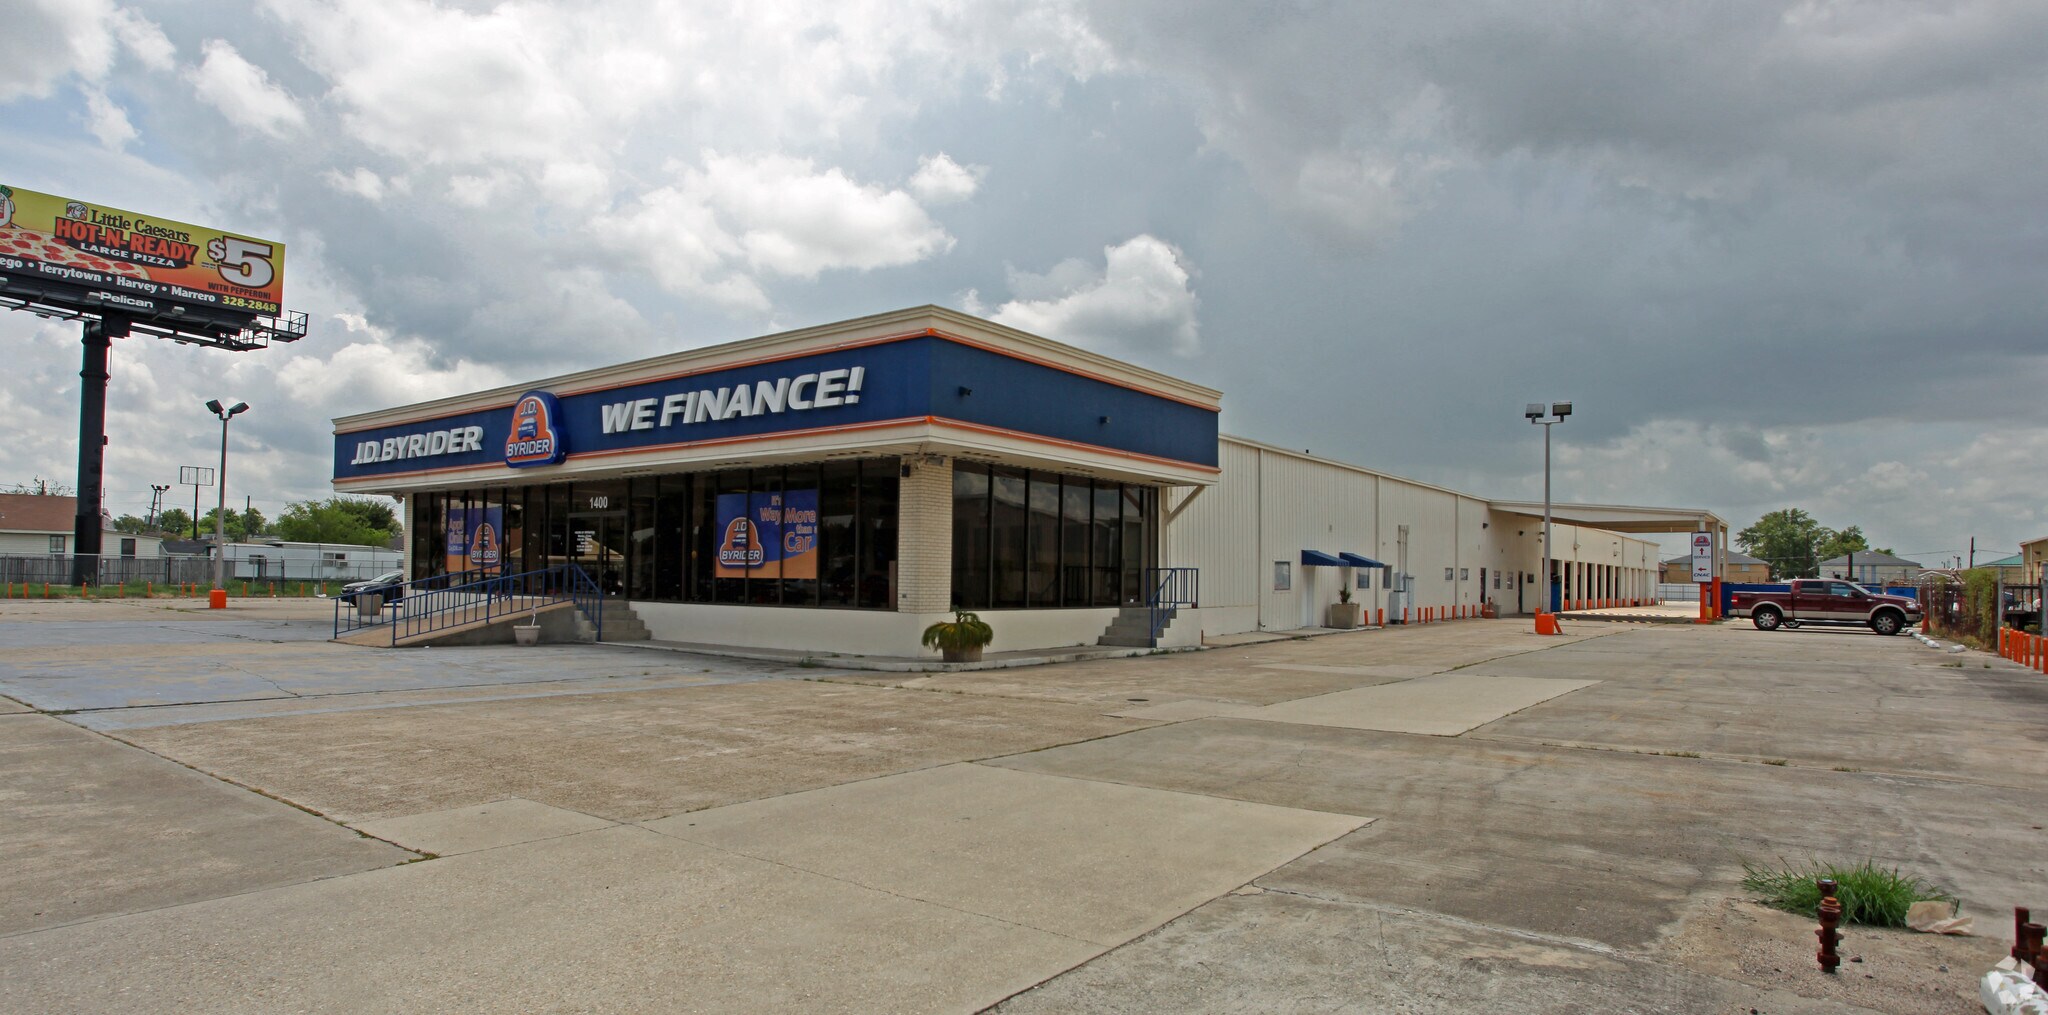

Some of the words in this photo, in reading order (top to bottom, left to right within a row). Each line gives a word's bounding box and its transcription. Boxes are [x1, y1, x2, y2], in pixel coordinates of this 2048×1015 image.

[91, 208, 131, 230] Little
[134, 219, 189, 243] Caesars
[80, 242, 129, 258] LARGE
[133, 252, 176, 268] PIZZA
[207, 235, 275, 289] $5
[38, 261, 102, 282] Terrytown
[116, 276, 158, 293] Harvey
[171, 286, 216, 302] Marrero
[222, 295, 277, 312] 328-2848
[207, 281, 229, 293] WITH
[230, 286, 271, 300] PEPPERONI
[100, 291, 154, 308] Pelican
[520, 401, 537, 416] J.D.
[602, 398, 658, 434] WE
[660, 366, 865, 427] FINANCE!
[507, 439, 550, 457] BYRIDER
[589, 496, 608, 509] 1400
[760, 507, 781, 525] Way
[784, 507, 817, 524] More
[784, 531, 812, 553] Car
